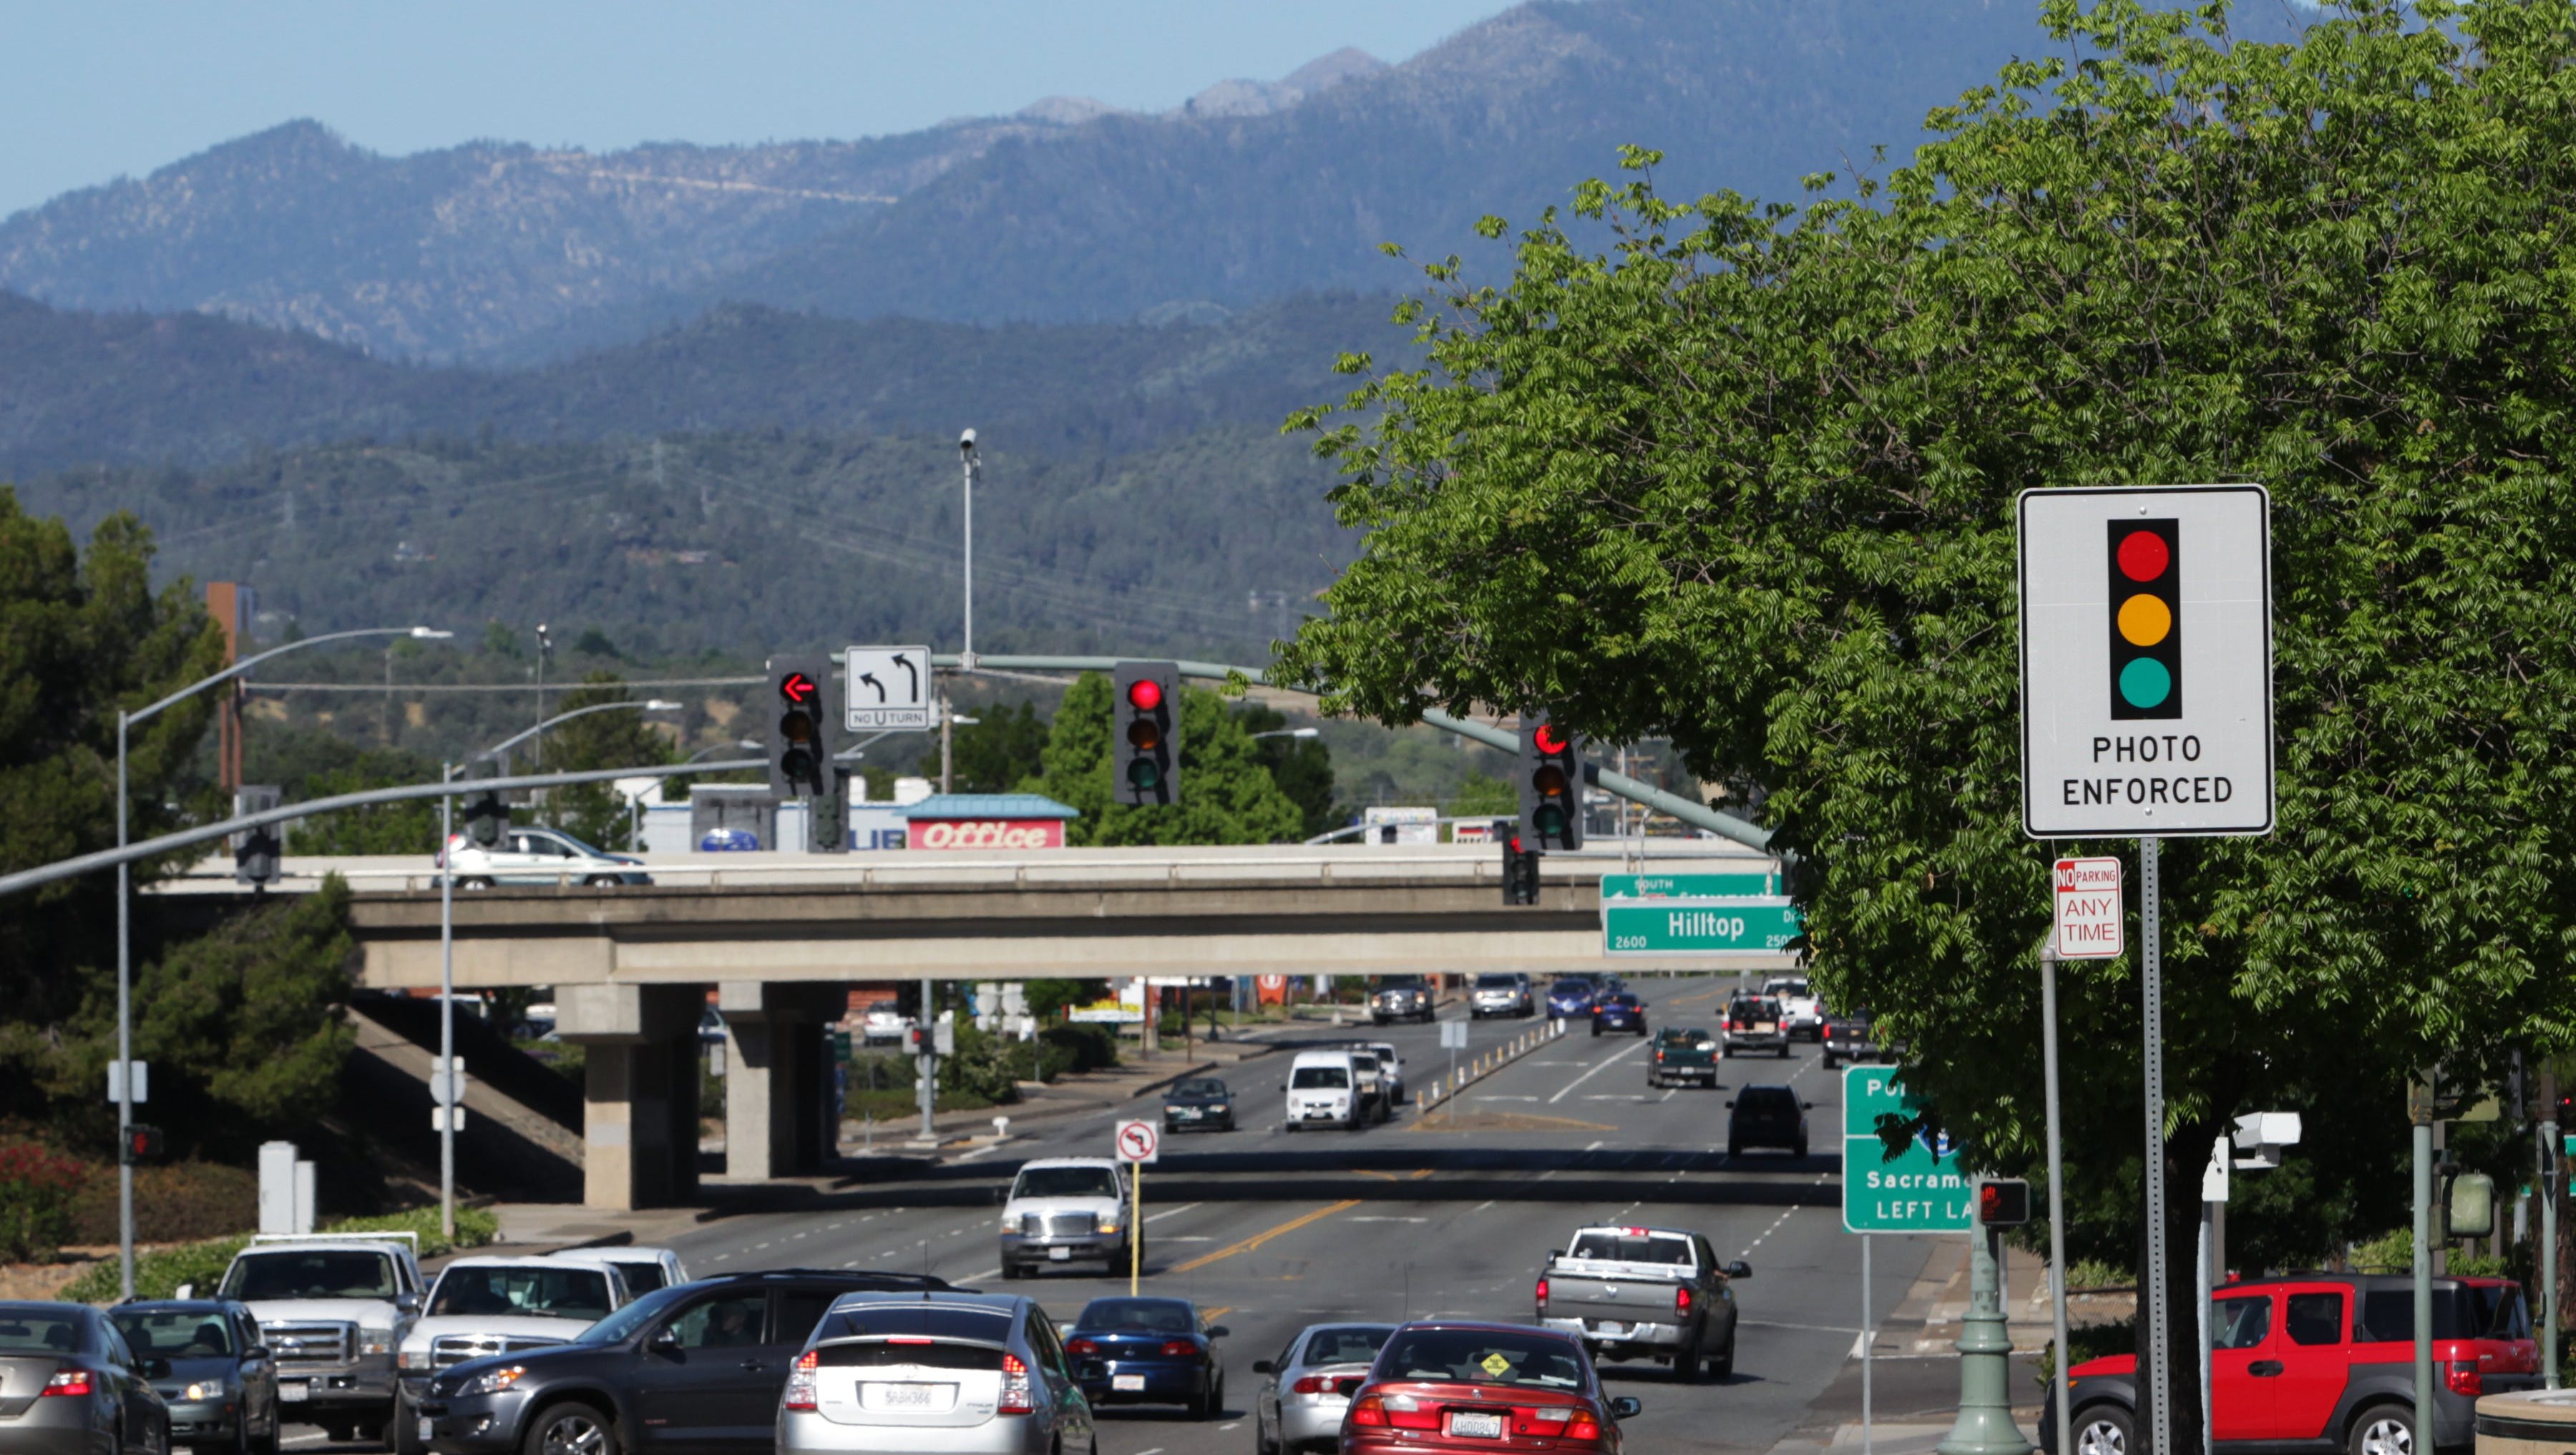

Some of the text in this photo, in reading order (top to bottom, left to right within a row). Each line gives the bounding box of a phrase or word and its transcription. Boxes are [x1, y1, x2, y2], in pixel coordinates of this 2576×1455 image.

[854, 711, 922, 725] NO U TURN
[2093, 735, 2200, 763] PHOTO
[2063, 777, 2233, 805] ENFORCED
[922, 821, 1047, 848] Office
[2057, 868, 2116, 887] NO PARKING
[2065, 898, 2112, 917] ANY
[1669, 912, 1745, 942] Hilltop
[2064, 923, 2115, 941] TIME
[1615, 935, 1647, 949] 2600
[1877, 1200, 1933, 1219] LEFT
